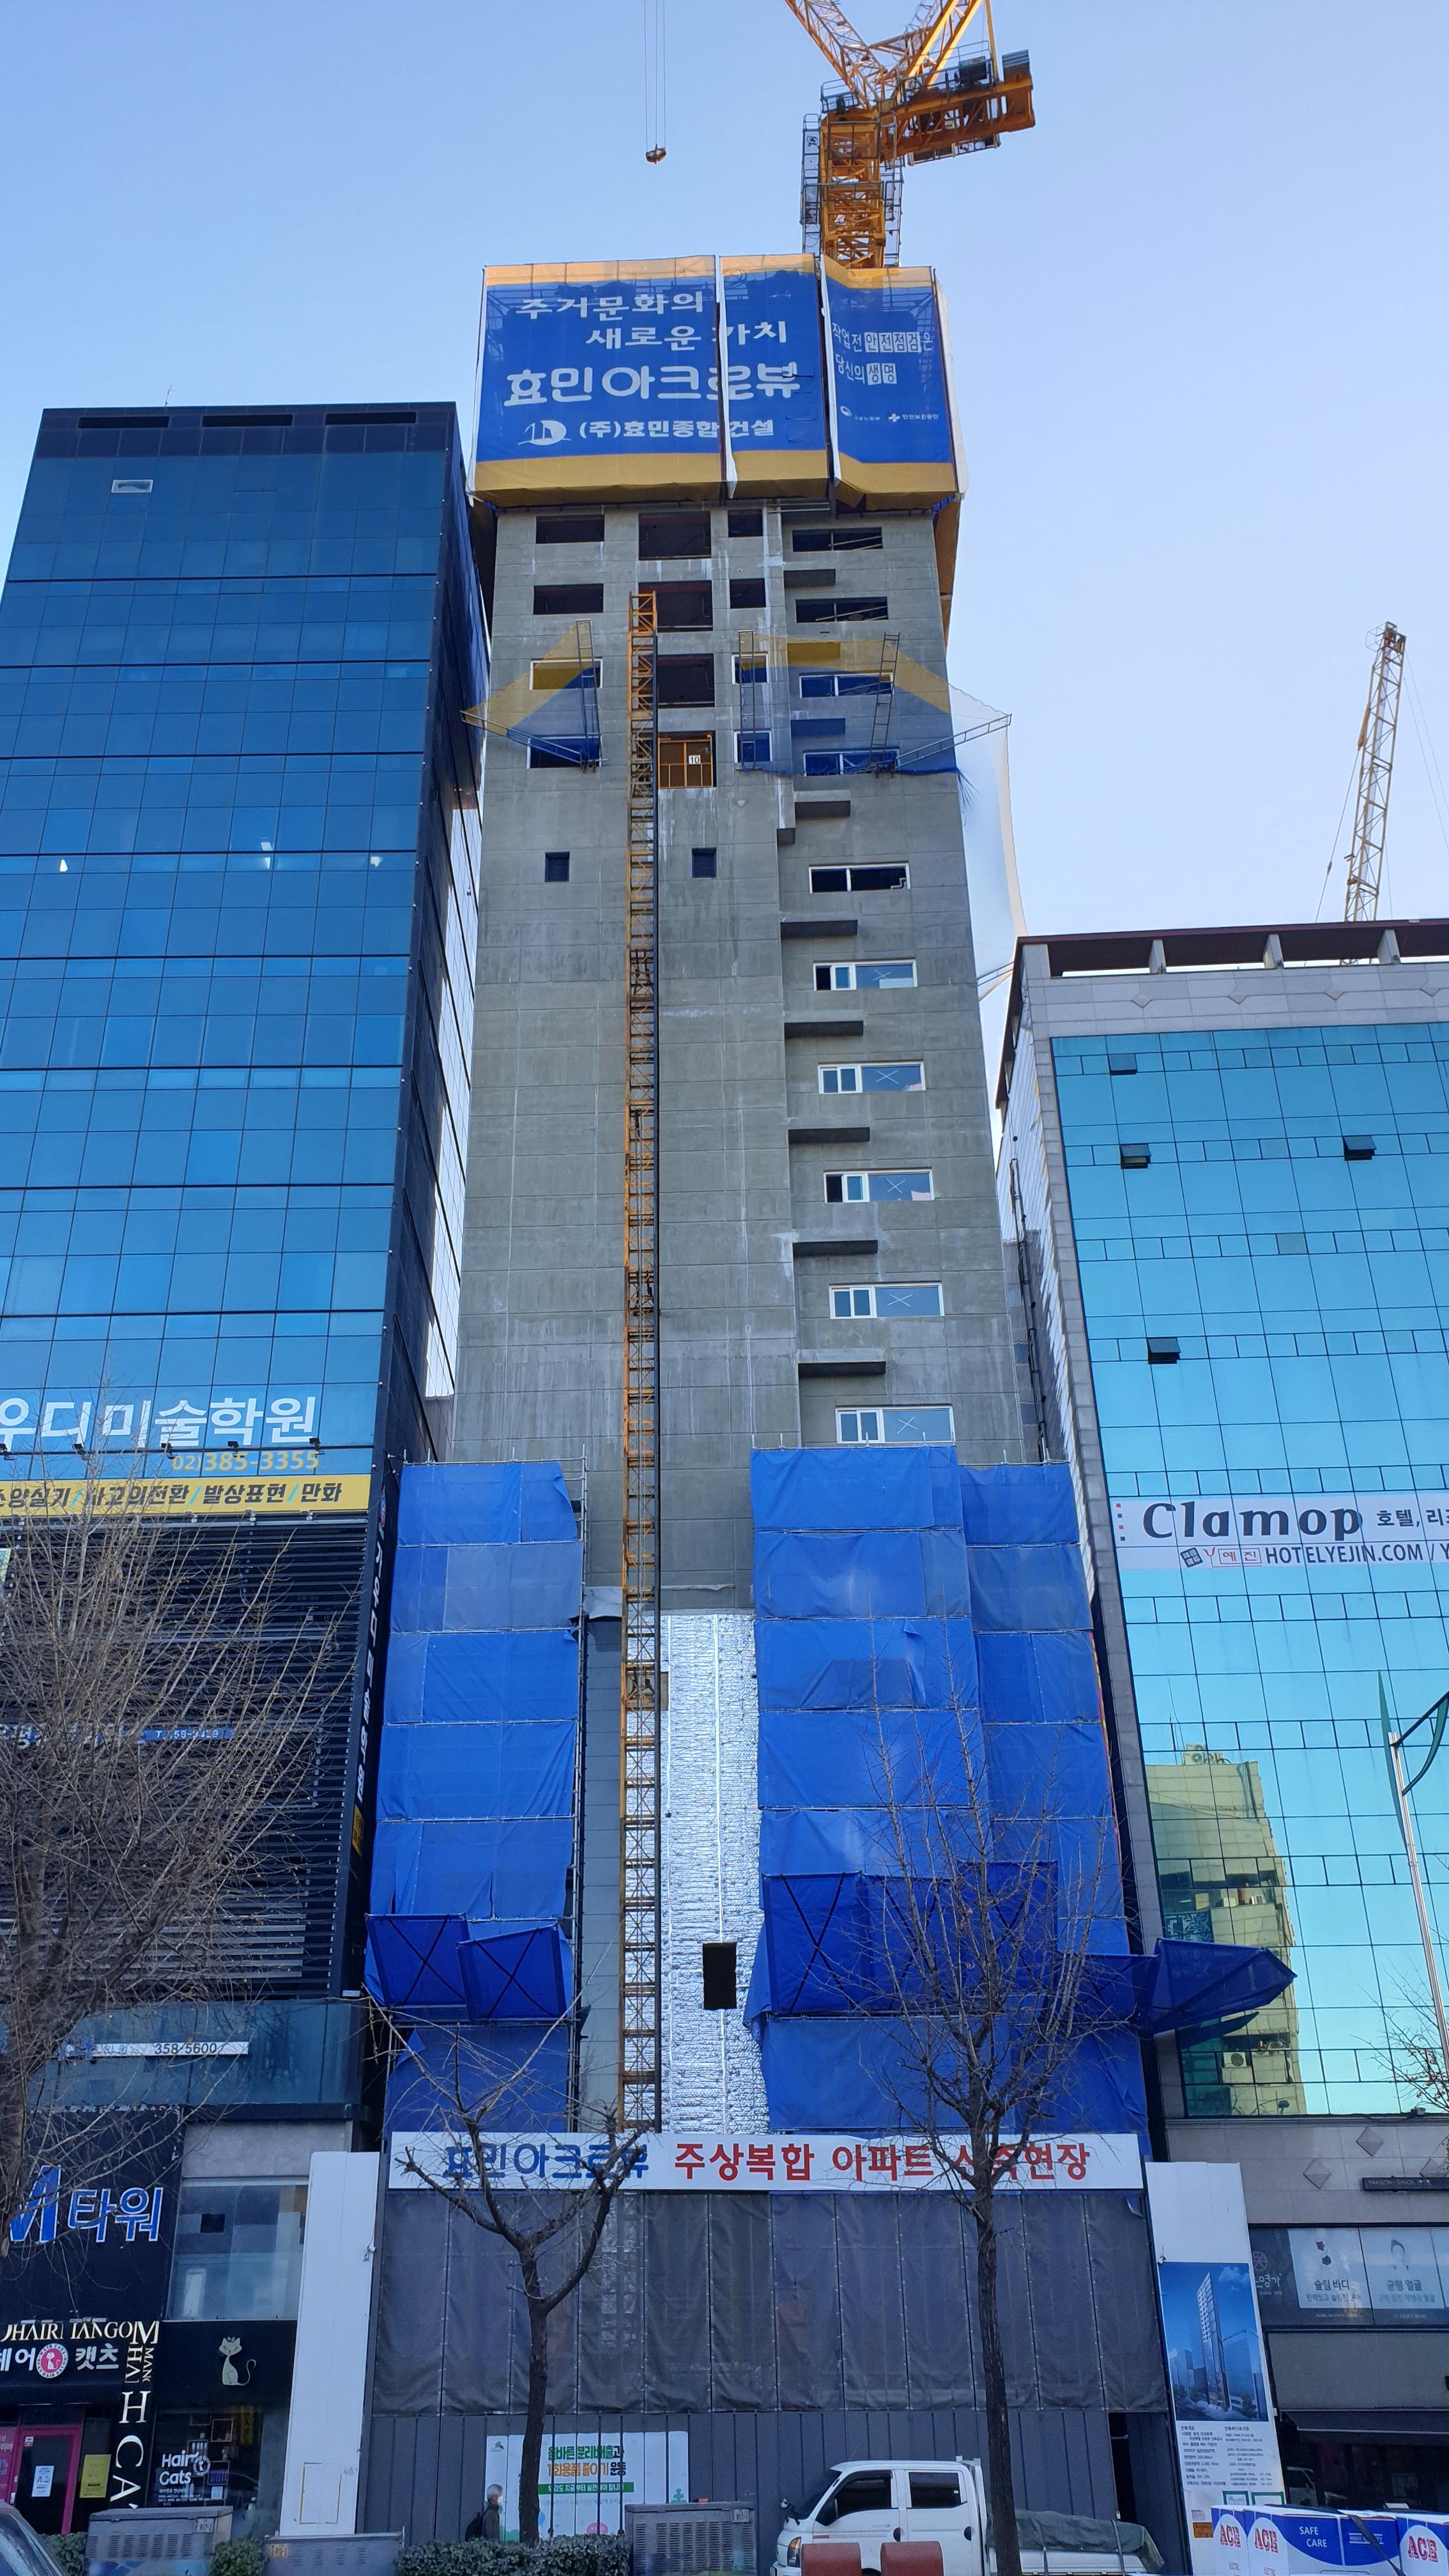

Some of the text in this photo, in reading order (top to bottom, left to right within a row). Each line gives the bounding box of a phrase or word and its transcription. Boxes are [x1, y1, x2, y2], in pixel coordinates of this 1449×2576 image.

[516, 292, 703, 321] 주거문화의
[585, 321, 787, 350] 새로운 가치
[835, 353, 897, 385] 당신의 생명
[503, 361, 801, 407] 효민아크로뷰
[689, 756, 700, 764] 10
[171, 1450, 319, 1471] 02)385-3355
[202, 1481, 287, 1504] 발상표현
[300, 1482, 342, 1503] 만화
[1142, 1500, 1363, 1542] Clamop
[1265, 1544, 1423, 1565] HOTELYEJIN.COM
[675, 2143, 815, 2182] 주상복합
[832, 2143, 935, 2182] 아파트
[1314, 2279, 1351, 2291] 슬림 바디
[75, 2343, 119, 2371] 캣츠
[161, 2450, 201, 2468] Hair
[159, 2470, 192, 2486] Cats
[1220, 2524, 1241, 2549] ACE
[1254, 2527, 1279, 2554] ACE
[1299, 2526, 1319, 2536] SAFE
[1306, 2538, 1328, 2549] CARE
[1407, 2534, 1439, 2563] ACE
